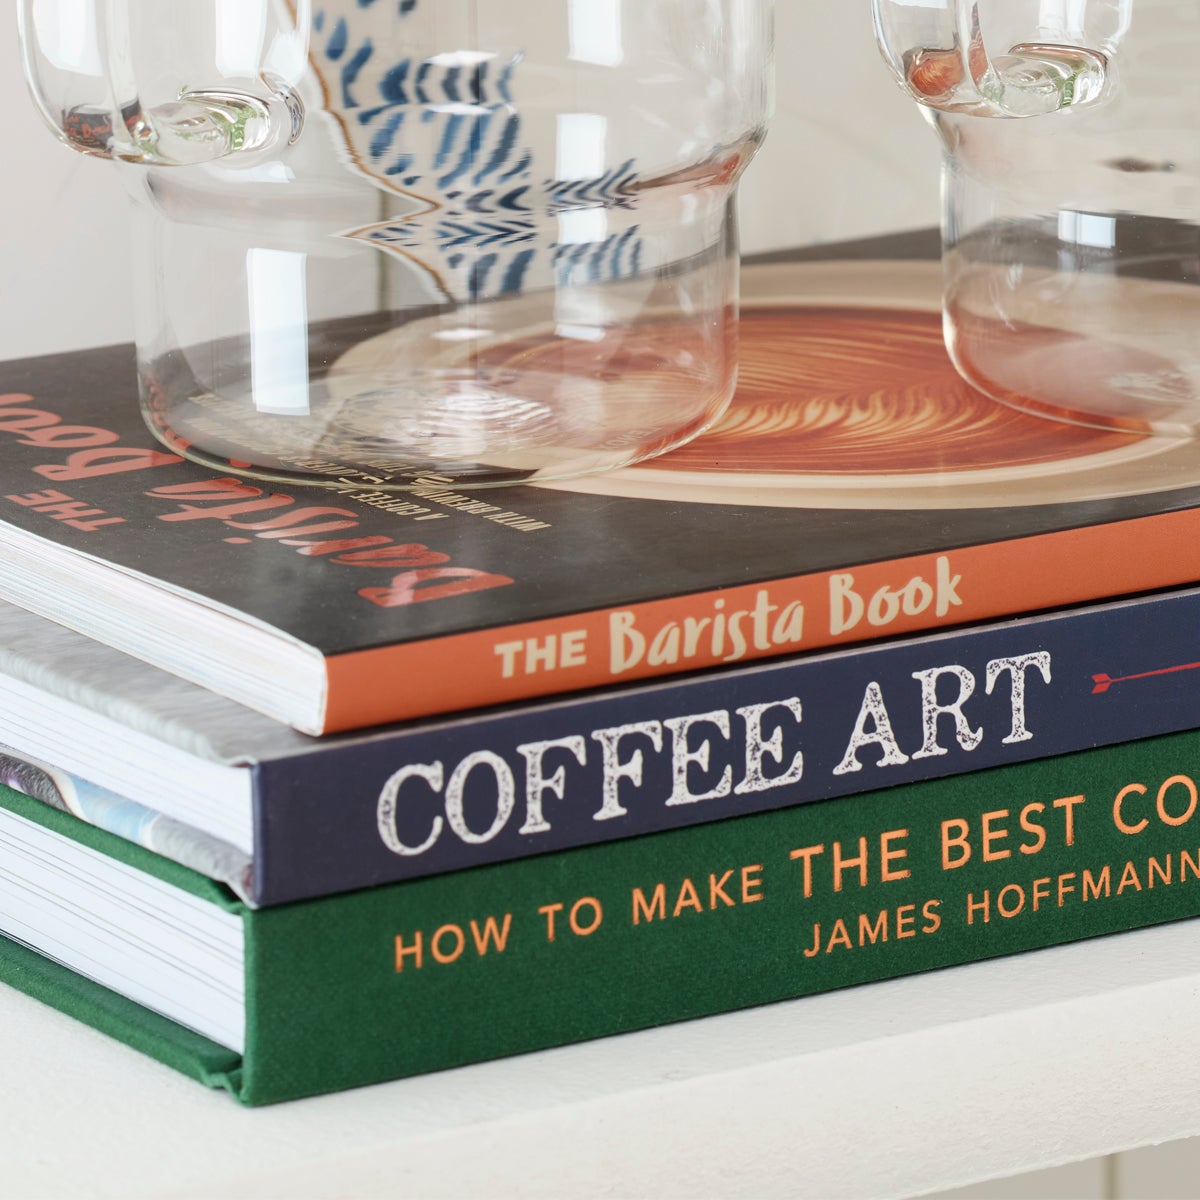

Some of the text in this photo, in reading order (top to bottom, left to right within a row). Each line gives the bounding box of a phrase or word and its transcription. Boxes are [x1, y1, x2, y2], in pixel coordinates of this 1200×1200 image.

[4, 489, 128, 532] THE
[350, 490, 432, 517] COFFEE
[413, 511, 449, 522] A
[483, 509, 552, 532] WITH
[144, 477, 515, 608] Barista
[495, 557, 964, 677] THE Barista Book
[377, 650, 1052, 856] COFFEE ART
[396, 914, 511, 971] HOW
[539, 897, 602, 940] TO
[633, 865, 762, 924] MAKE
[790, 829, 910, 897] THE
[941, 795, 1086, 870] BEST
[804, 899, 940, 957] JAMES
